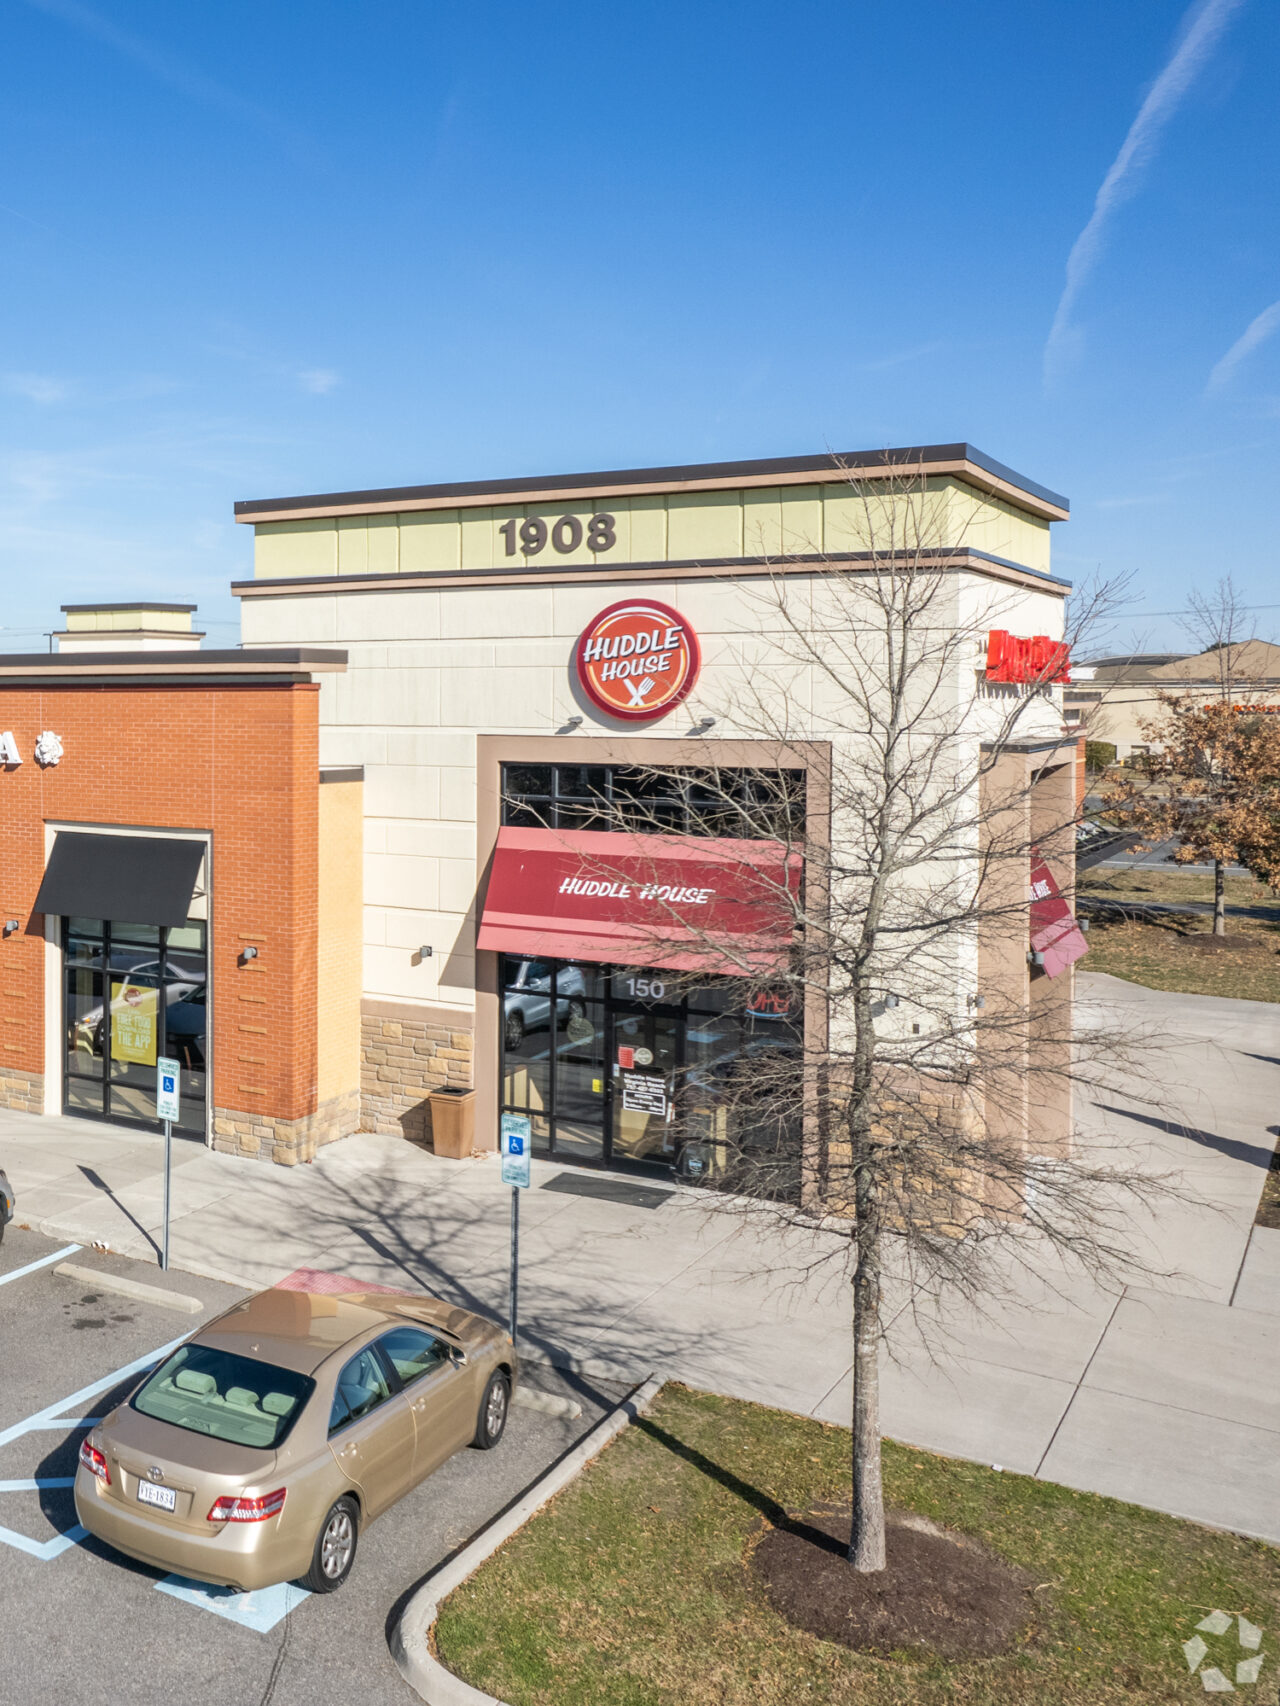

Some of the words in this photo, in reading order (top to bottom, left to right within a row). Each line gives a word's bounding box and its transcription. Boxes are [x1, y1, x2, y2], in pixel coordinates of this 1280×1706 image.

[499, 513, 617, 557] 1908
[583, 626, 683, 662] HUDDLE
[601, 653, 672, 681] HOUSE
[559, 877, 631, 898] HUDDLE
[639, 882, 716, 904] HOUSE
[626, 978, 665, 999] 150
[117, 1031, 133, 1047] THE
[134, 1034, 151, 1049] APP
